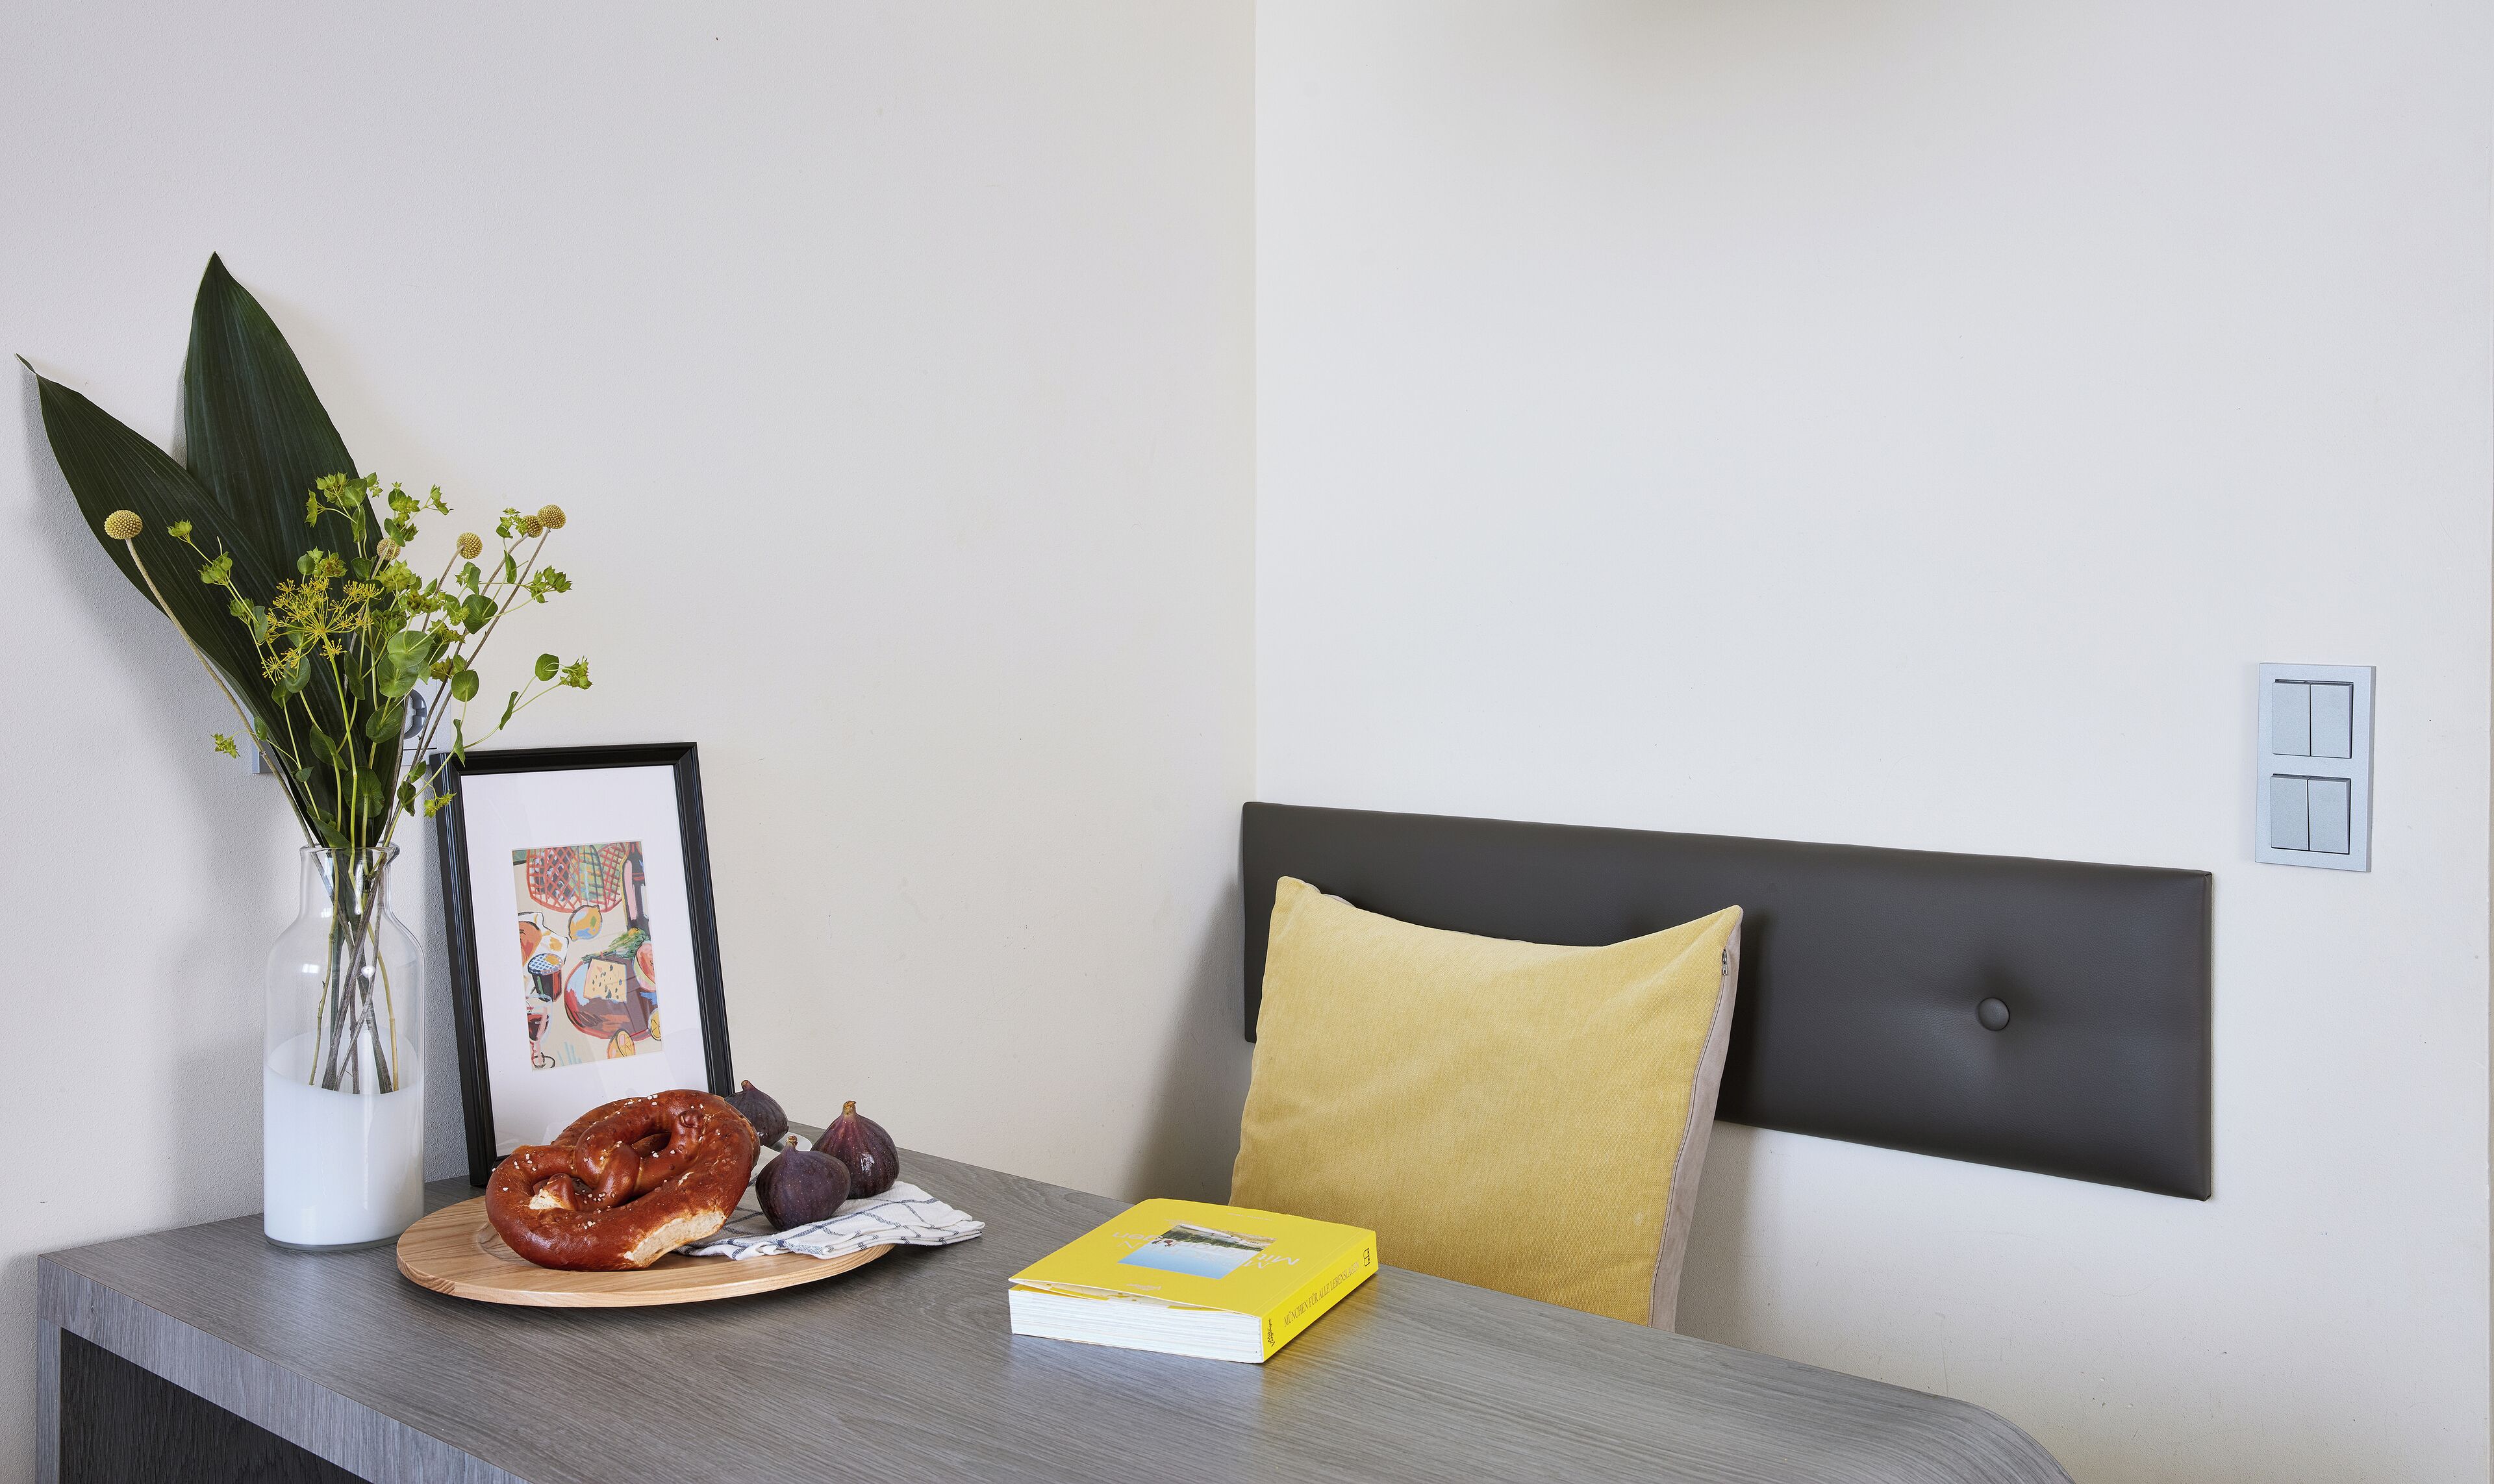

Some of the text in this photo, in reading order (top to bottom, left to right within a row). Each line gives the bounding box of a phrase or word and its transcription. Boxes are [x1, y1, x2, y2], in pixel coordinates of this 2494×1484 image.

[1256, 1253, 1300, 1266] Mit
[1283, 1261, 1359, 1327] MÜNCHEN FÜR ALLE LEBENSLAGEN
